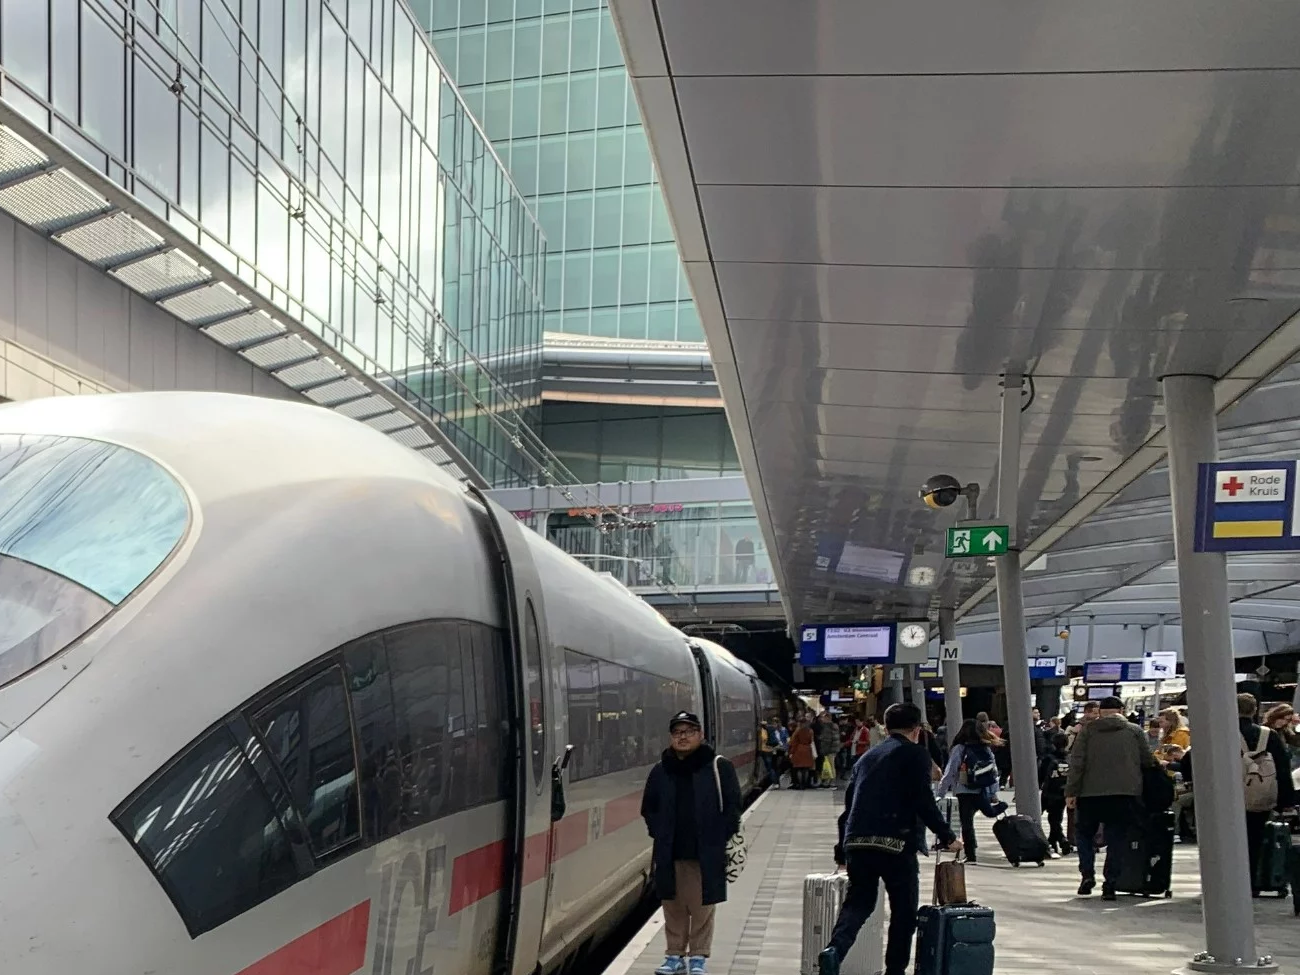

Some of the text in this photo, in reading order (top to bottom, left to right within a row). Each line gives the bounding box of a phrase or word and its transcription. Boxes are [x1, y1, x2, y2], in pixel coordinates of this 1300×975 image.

[1249, 475, 1281, 485] Rode
[1249, 486, 1279, 496] Kruis
[944, 648, 958, 659] M
